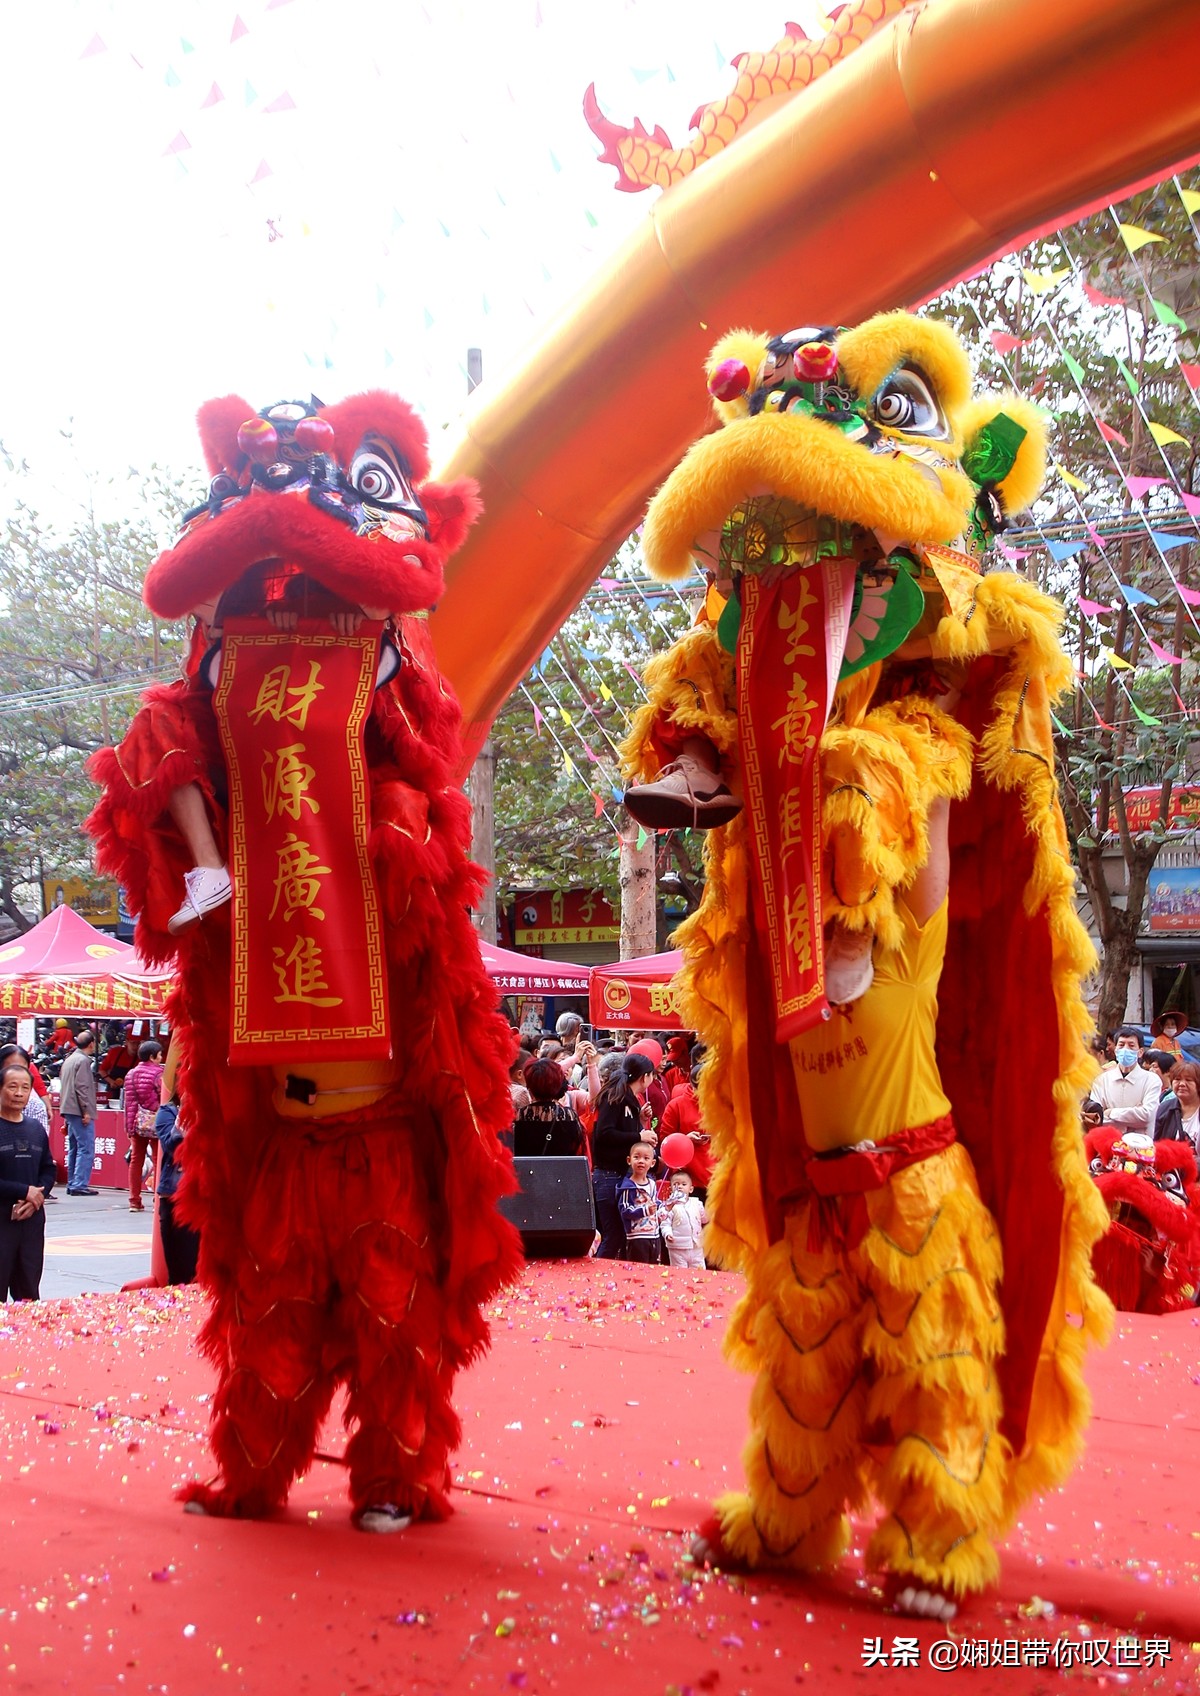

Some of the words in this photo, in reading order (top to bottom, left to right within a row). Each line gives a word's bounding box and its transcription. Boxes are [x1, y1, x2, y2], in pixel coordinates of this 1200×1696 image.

[246, 659, 344, 1008] 財源廣進
[607, 987, 627, 1001] CP
[605, 1011, 631, 1020] 正大食品
